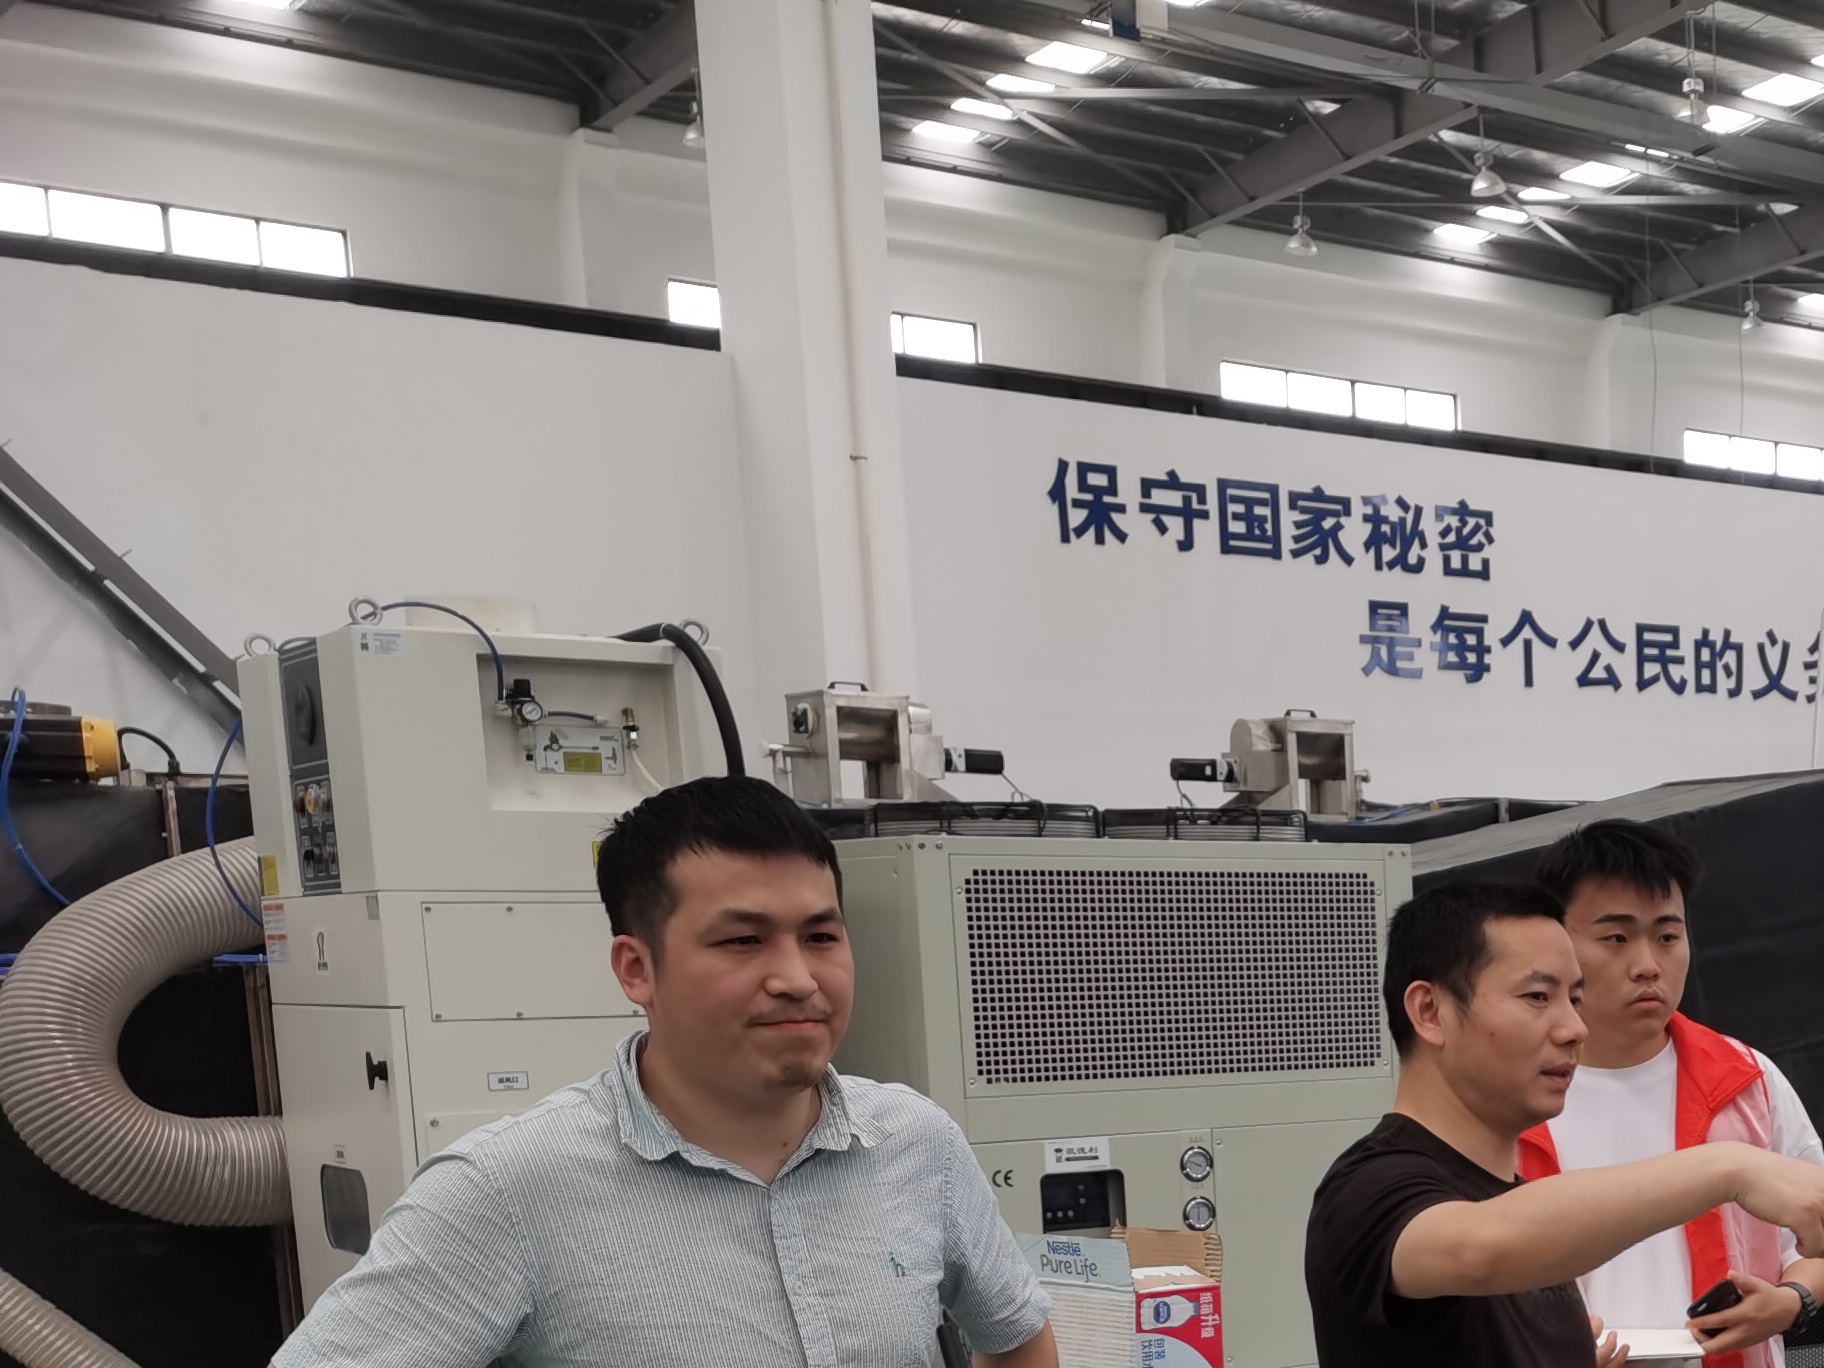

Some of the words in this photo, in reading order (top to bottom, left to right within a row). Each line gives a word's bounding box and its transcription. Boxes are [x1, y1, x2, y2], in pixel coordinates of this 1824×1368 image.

[1047, 457, 1495, 582] 保守国家秘密
[1040, 1253, 1073, 1275] Pure
